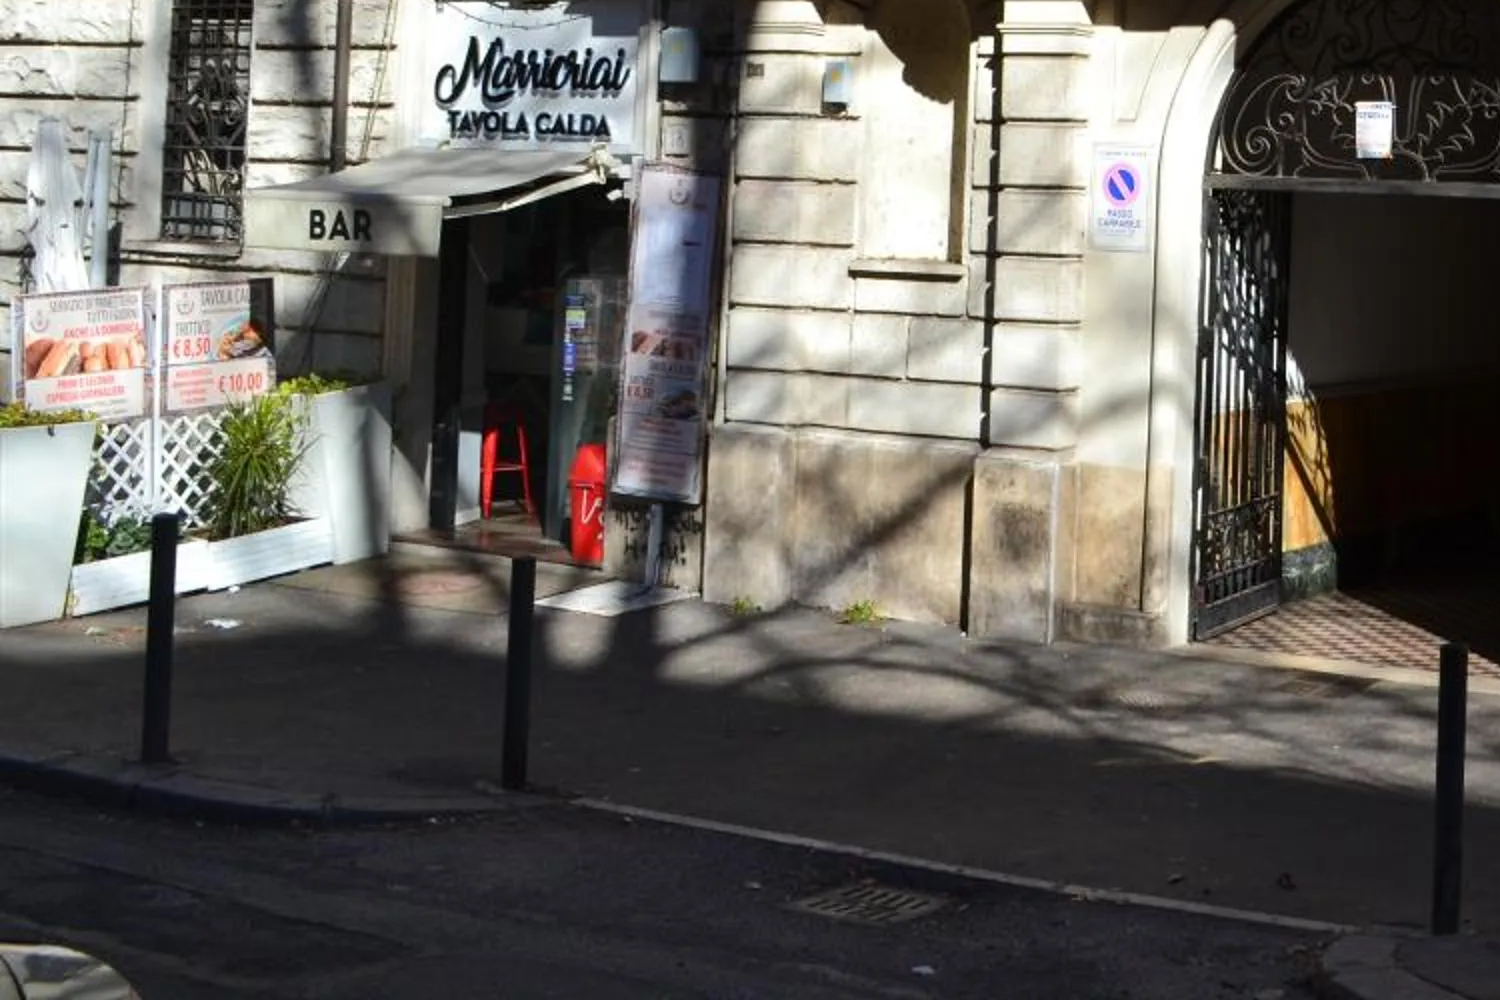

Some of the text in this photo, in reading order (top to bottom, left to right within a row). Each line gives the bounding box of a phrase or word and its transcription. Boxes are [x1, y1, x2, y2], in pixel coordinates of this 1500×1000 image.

[448, 110, 611, 138] TAVOLA CALDA
[308, 208, 373, 241] BAR
[183, 336, 211, 357] 8,50
[229, 371, 263, 393] 10,00
